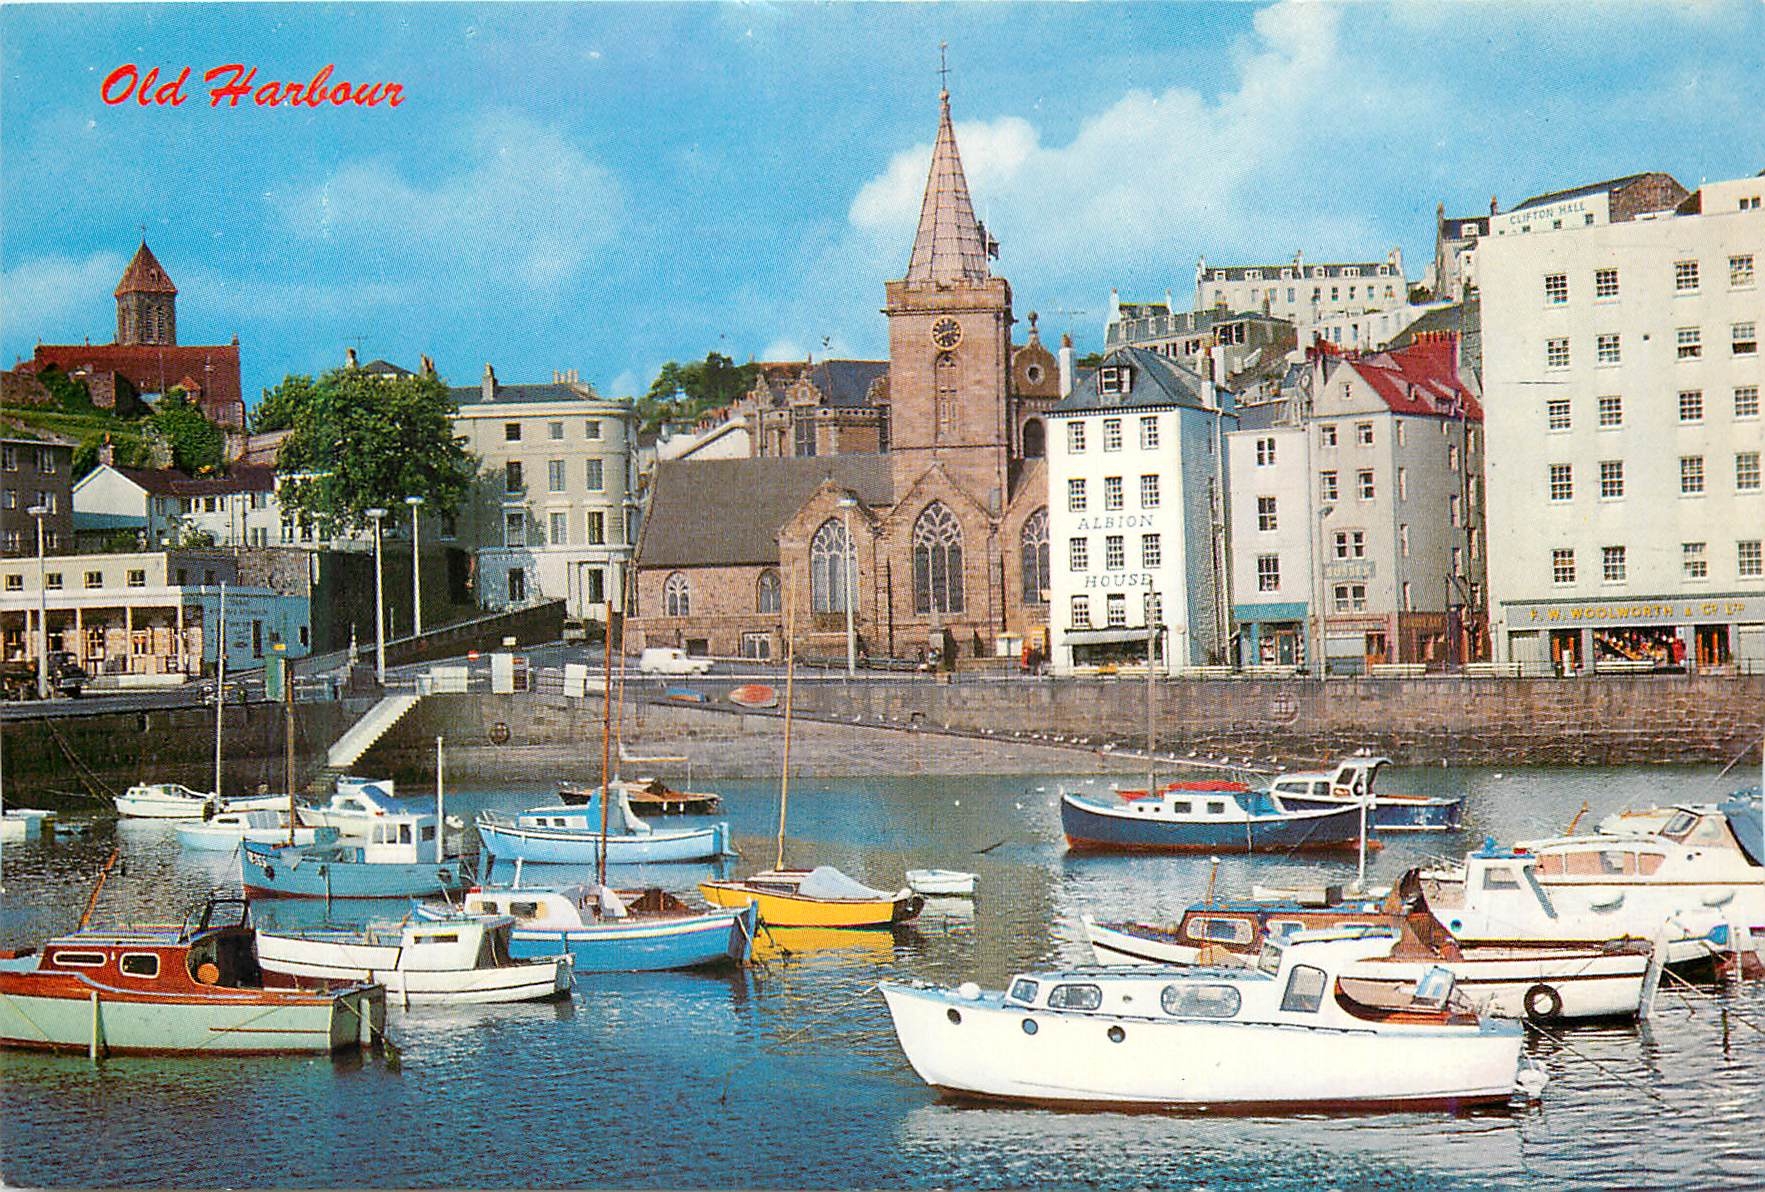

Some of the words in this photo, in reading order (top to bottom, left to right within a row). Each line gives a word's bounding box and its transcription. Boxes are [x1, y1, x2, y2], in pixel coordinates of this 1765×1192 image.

[1509, 207, 1554, 225] CLIFTON
[1558, 201, 1585, 215] HALL
[1077, 514, 1155, 530] ALBION
[1084, 573, 1153, 588] HOUSE
[1570, 604, 1673, 620] WOOLWORTH
